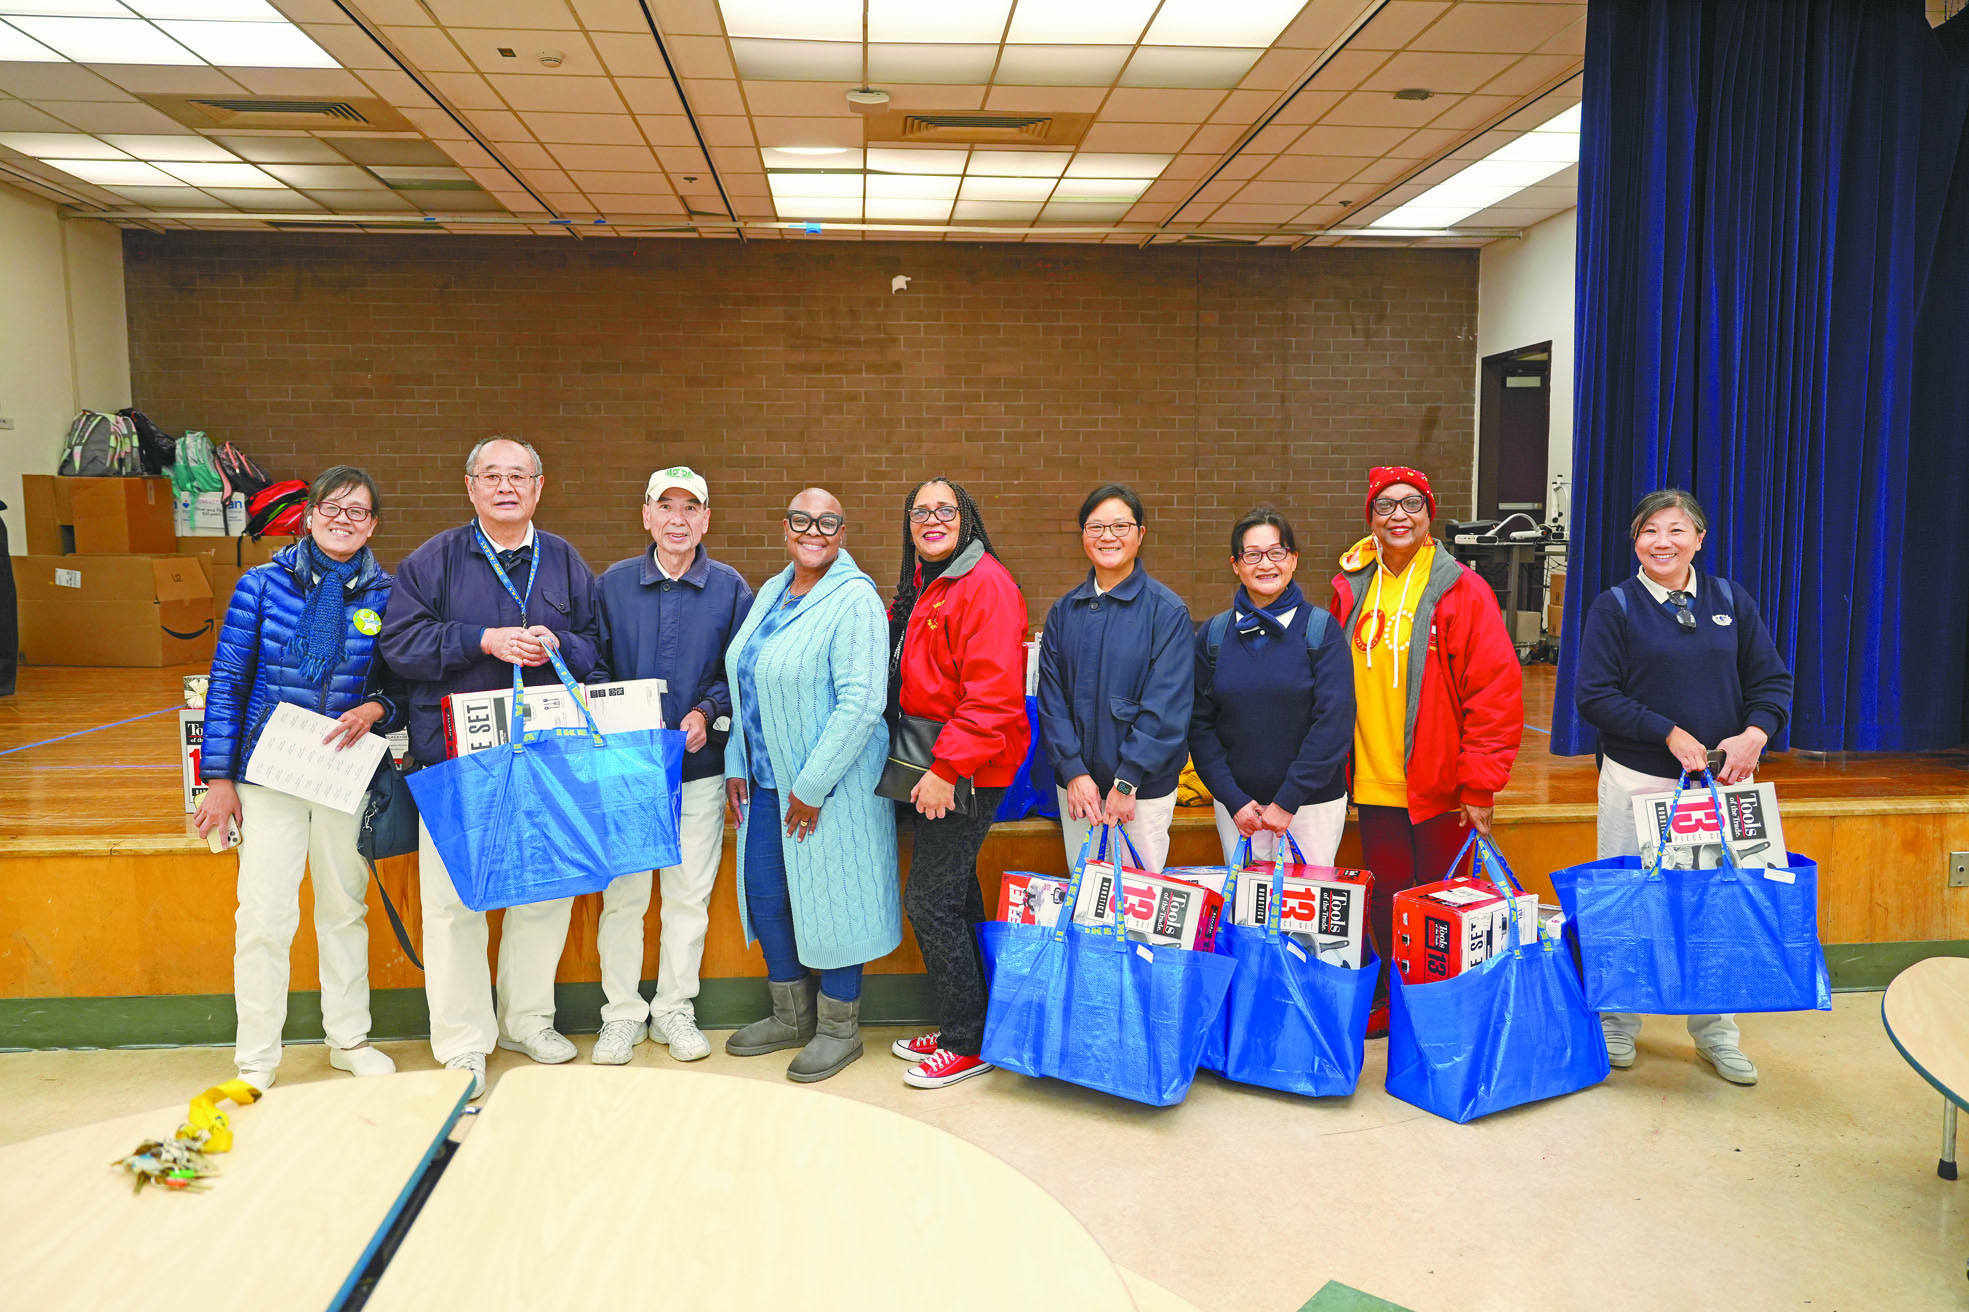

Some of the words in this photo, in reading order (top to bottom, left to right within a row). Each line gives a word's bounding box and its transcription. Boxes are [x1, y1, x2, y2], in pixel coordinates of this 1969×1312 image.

[514, 678, 524, 717] IKEA
[467, 704, 491, 734] SET
[556, 728, 588, 736] IKE
[1670, 796, 1726, 834] 13
[1729, 797, 1736, 805] of
[1740, 792, 1762, 837] Tools
[1064, 867, 1083, 907] IKEA
[1163, 892, 1169, 900] of
[1223, 863, 1241, 902] IKEA
[1323, 892, 1329, 901] of
[1497, 880, 1517, 922] IKEA
[1109, 883, 1157, 921] 13
[1165, 893, 1187, 935] Tools
[1268, 887, 1316, 922] 13
[1269, 893, 1280, 935] IKEA
[1330, 891, 1348, 933] Tools
[1085, 926, 1113, 935] IKE
[1117, 901, 1125, 942] IKEA
[1439, 924, 1448, 949] Tools
[1471, 922, 1483, 951] SET
[1427, 953, 1447, 977] 13
